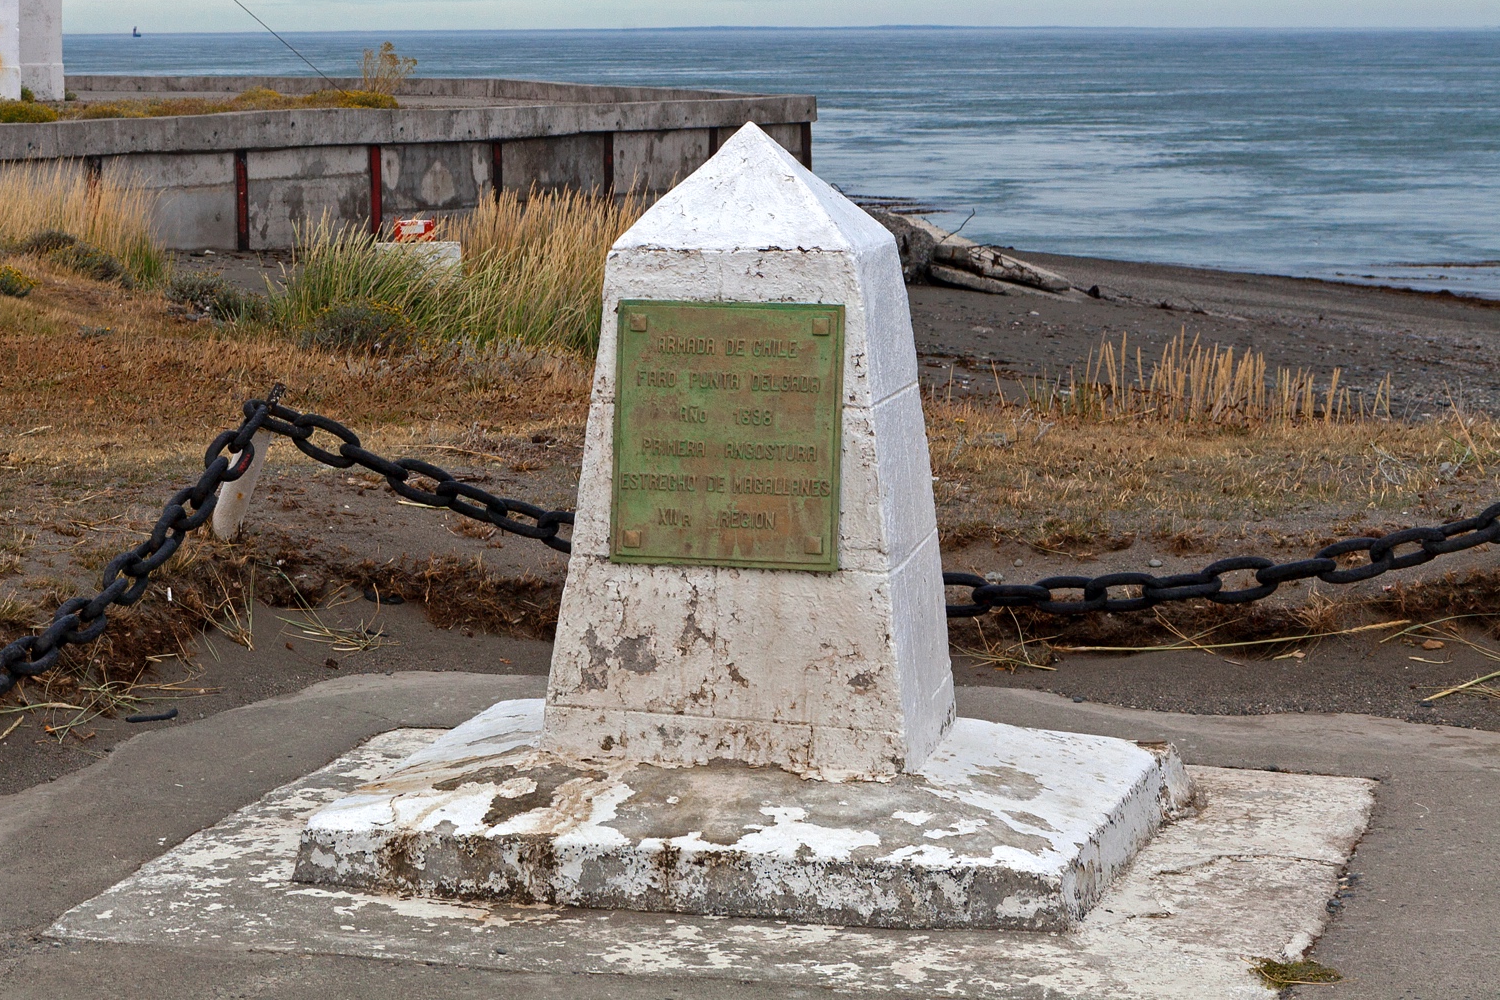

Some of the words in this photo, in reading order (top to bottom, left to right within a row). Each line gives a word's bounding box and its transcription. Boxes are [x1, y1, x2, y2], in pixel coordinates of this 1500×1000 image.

[657, 336, 715, 355] ARMADA
[725, 339, 746, 356] DE
[752, 339, 798, 358] CHILE
[637, 370, 677, 388] FARO
[689, 371, 740, 390] PUNTA
[751, 374, 821, 393] DELGADA
[679, 405, 708, 424] AÑO
[732, 407, 774, 426] 1898
[642, 438, 707, 457] PRIMERA
[724, 442, 818, 462] ANGOSTURA
[620, 472, 697, 491] ESTRECHO
[706, 476, 725, 493] DE
[732, 476, 831, 497] MAGALLANES
[719, 510, 776, 529] REGION
